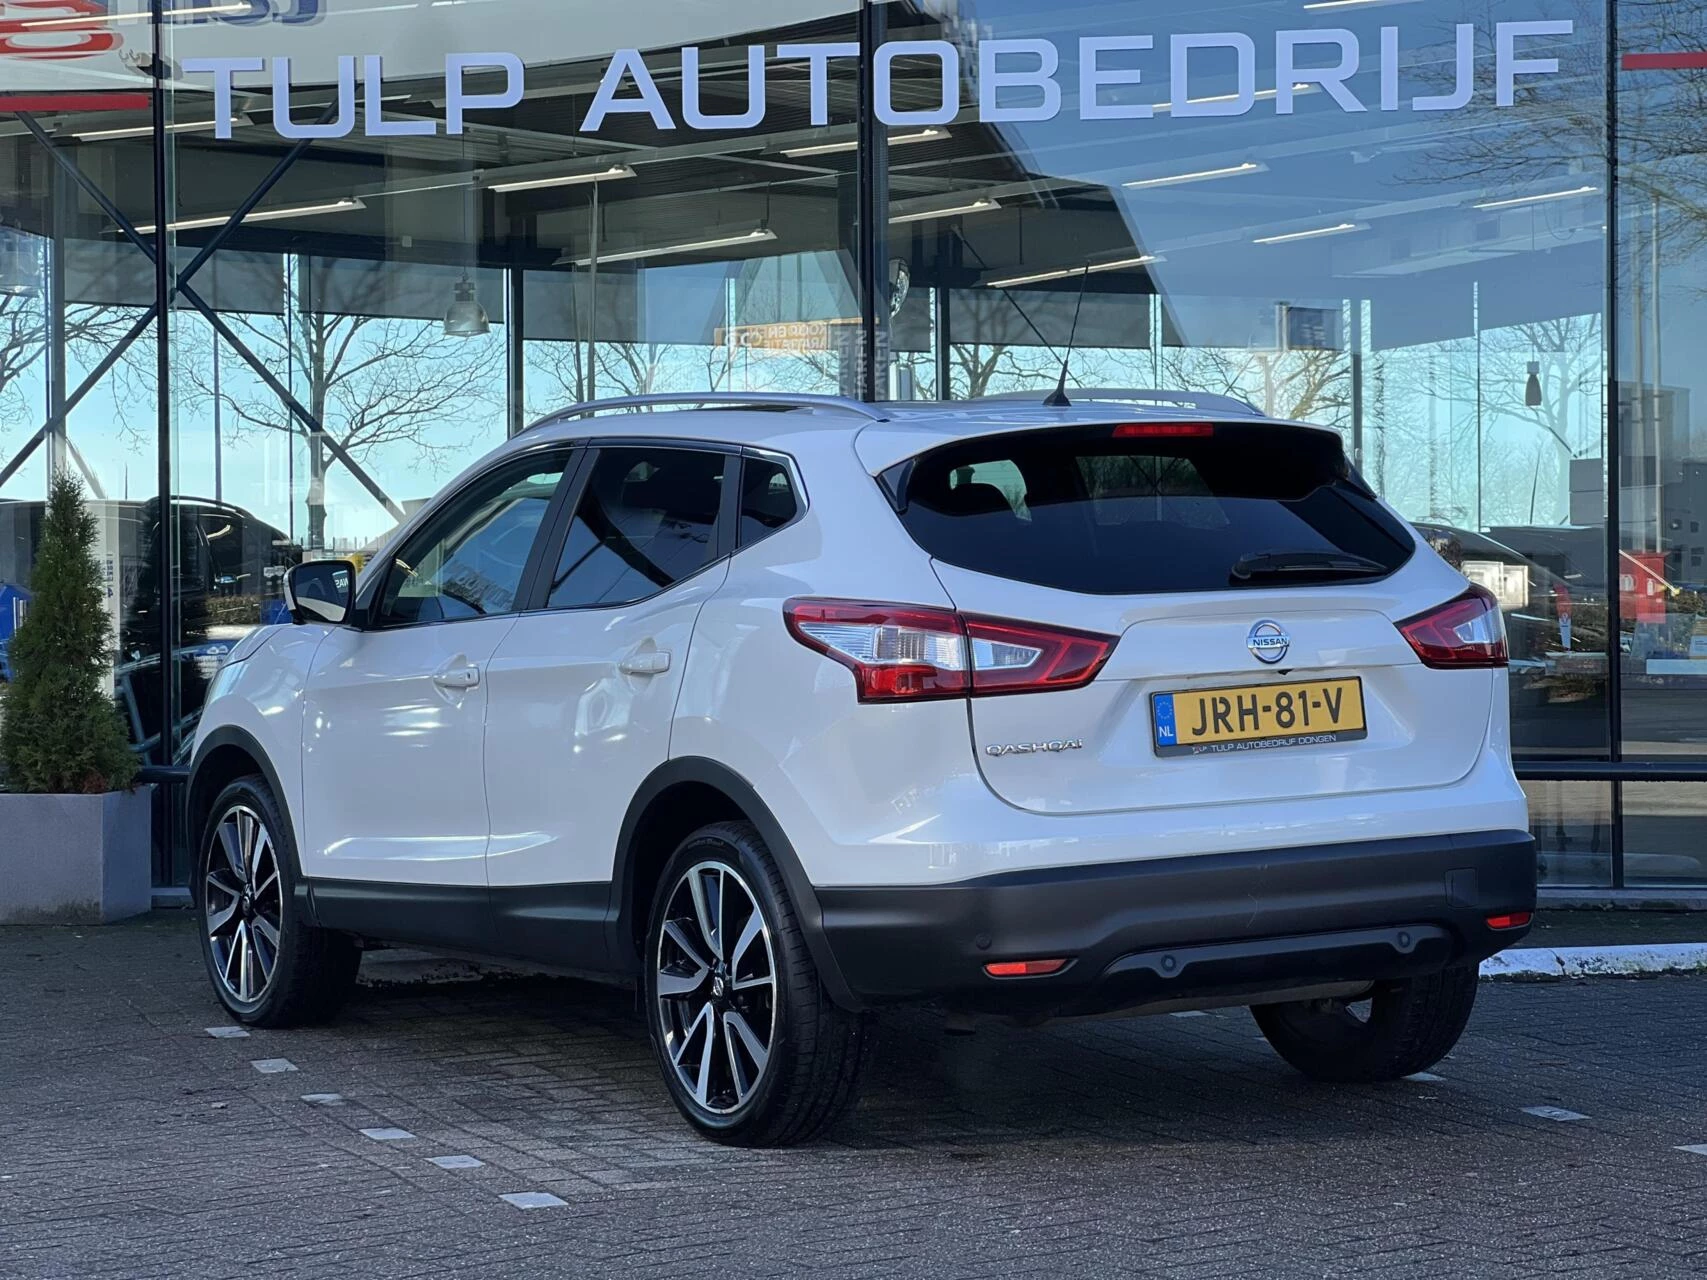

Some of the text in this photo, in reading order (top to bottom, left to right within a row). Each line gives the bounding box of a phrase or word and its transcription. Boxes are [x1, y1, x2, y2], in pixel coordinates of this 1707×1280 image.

[181, 19, 1574, 139] TULP AUTOBEDRIJF
[1252, 637, 1288, 647] NISSAN
[1191, 686, 1343, 737] JRH-81-V
[1158, 725, 1175, 738] NL
[985, 738, 1083, 757] QASHQAI
[1210, 743, 1235, 753] TULP
[1237, 736, 1297, 751] AUTOBEDRIJF
[1297, 734, 1337, 746] DONGEN
